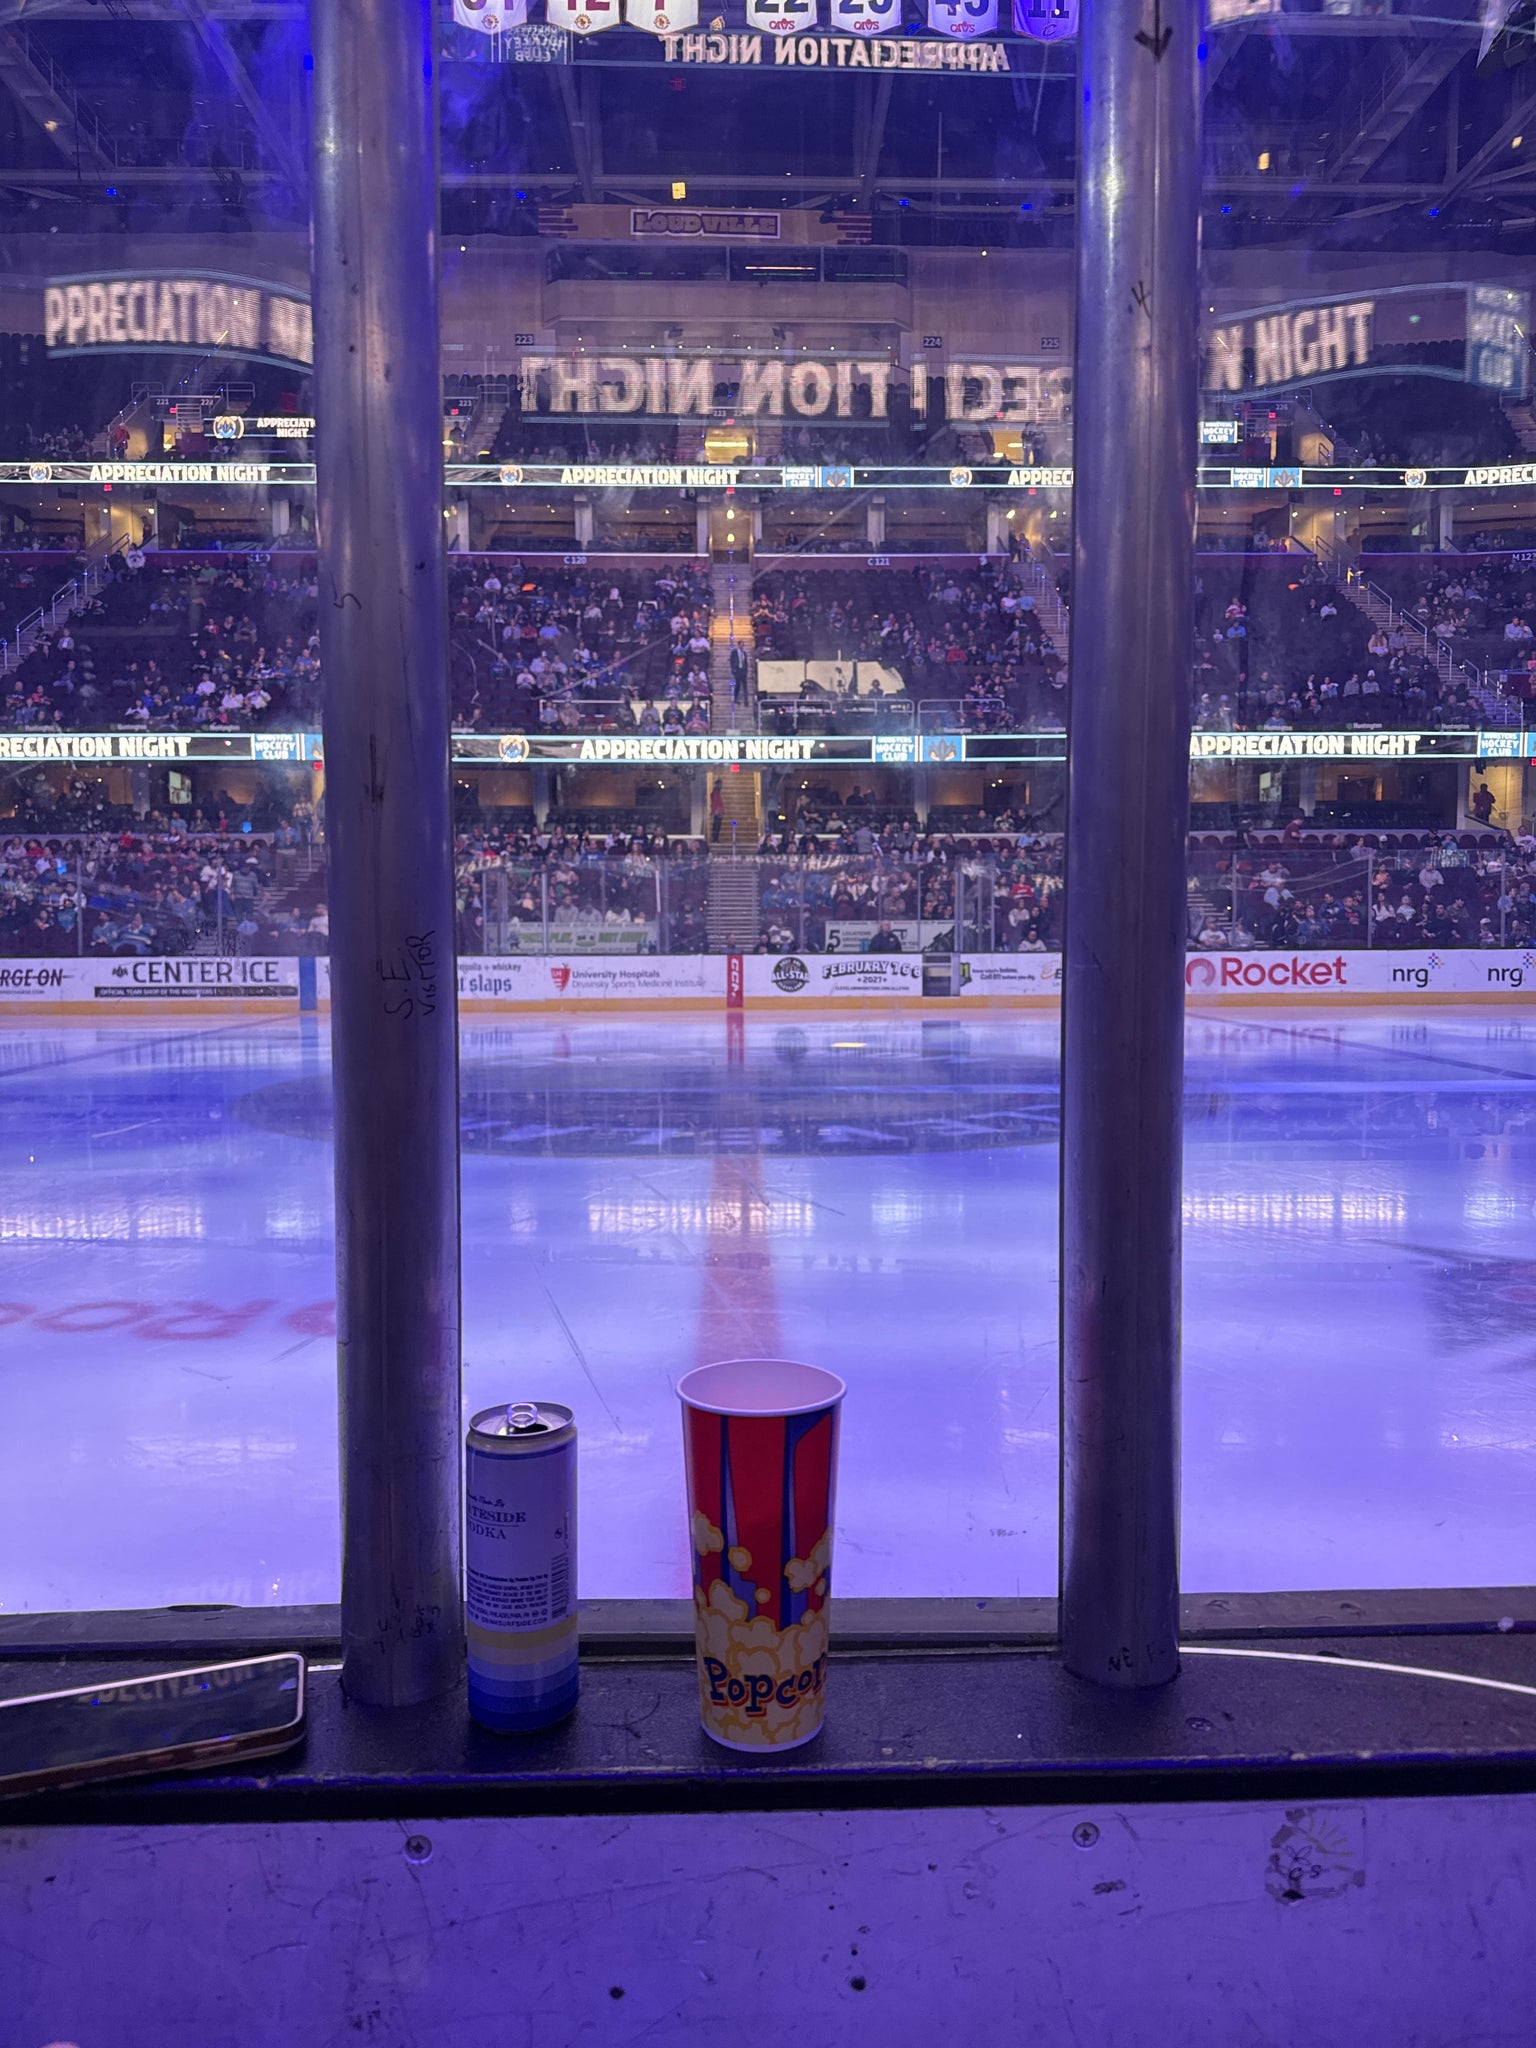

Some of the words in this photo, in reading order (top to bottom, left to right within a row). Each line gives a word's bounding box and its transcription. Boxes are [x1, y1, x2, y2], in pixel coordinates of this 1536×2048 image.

[769, 19, 795, 30] CAVS
[854, 19, 879, 30] CAVS
[950, 21, 975, 33] CAVS
[634, 211, 777, 235] LOUDVILLE
[516, 336, 533, 344] 223
[1254, 301, 1375, 386] NIGHT
[277, 428, 308, 438] NIGHT
[90, 464, 212, 481] APPRECIATION
[217, 464, 270, 482] NIGHT
[561, 468, 684, 485] APPRECIATION
[686, 469, 739, 486] NIGHT
[0, 737, 111, 757] RECIATION
[119, 736, 191, 757] NIGHT
[255, 741, 296, 751] HOCKEY
[580, 739, 738, 760] APPRECIATION
[746, 739, 815, 760] NIGHT
[1189, 735, 1344, 756] APPRECIATION
[1351, 735, 1420, 755] NIGHT
[1481, 740, 1519, 749] HOCKEY
[1487, 748, 1512, 757] CLUB
[262, 750, 289, 760] CLUB
[882, 752, 907, 761] CLUB
[133, 962, 232, 983] CENTER
[242, 961, 279, 983] ICE
[572, 971, 617, 981] University
[619, 969, 660, 980] Hospitals
[823, 961, 888, 979] FEBRUARY
[1221, 955, 1347, 986] Rocket
[1393, 967, 1428, 987] nrg
[1488, 967, 1523, 987] nrg
[469, 974, 512, 996] slaps
[611, 981, 635, 989] Sports
[638, 980, 672, 988] Medicine
